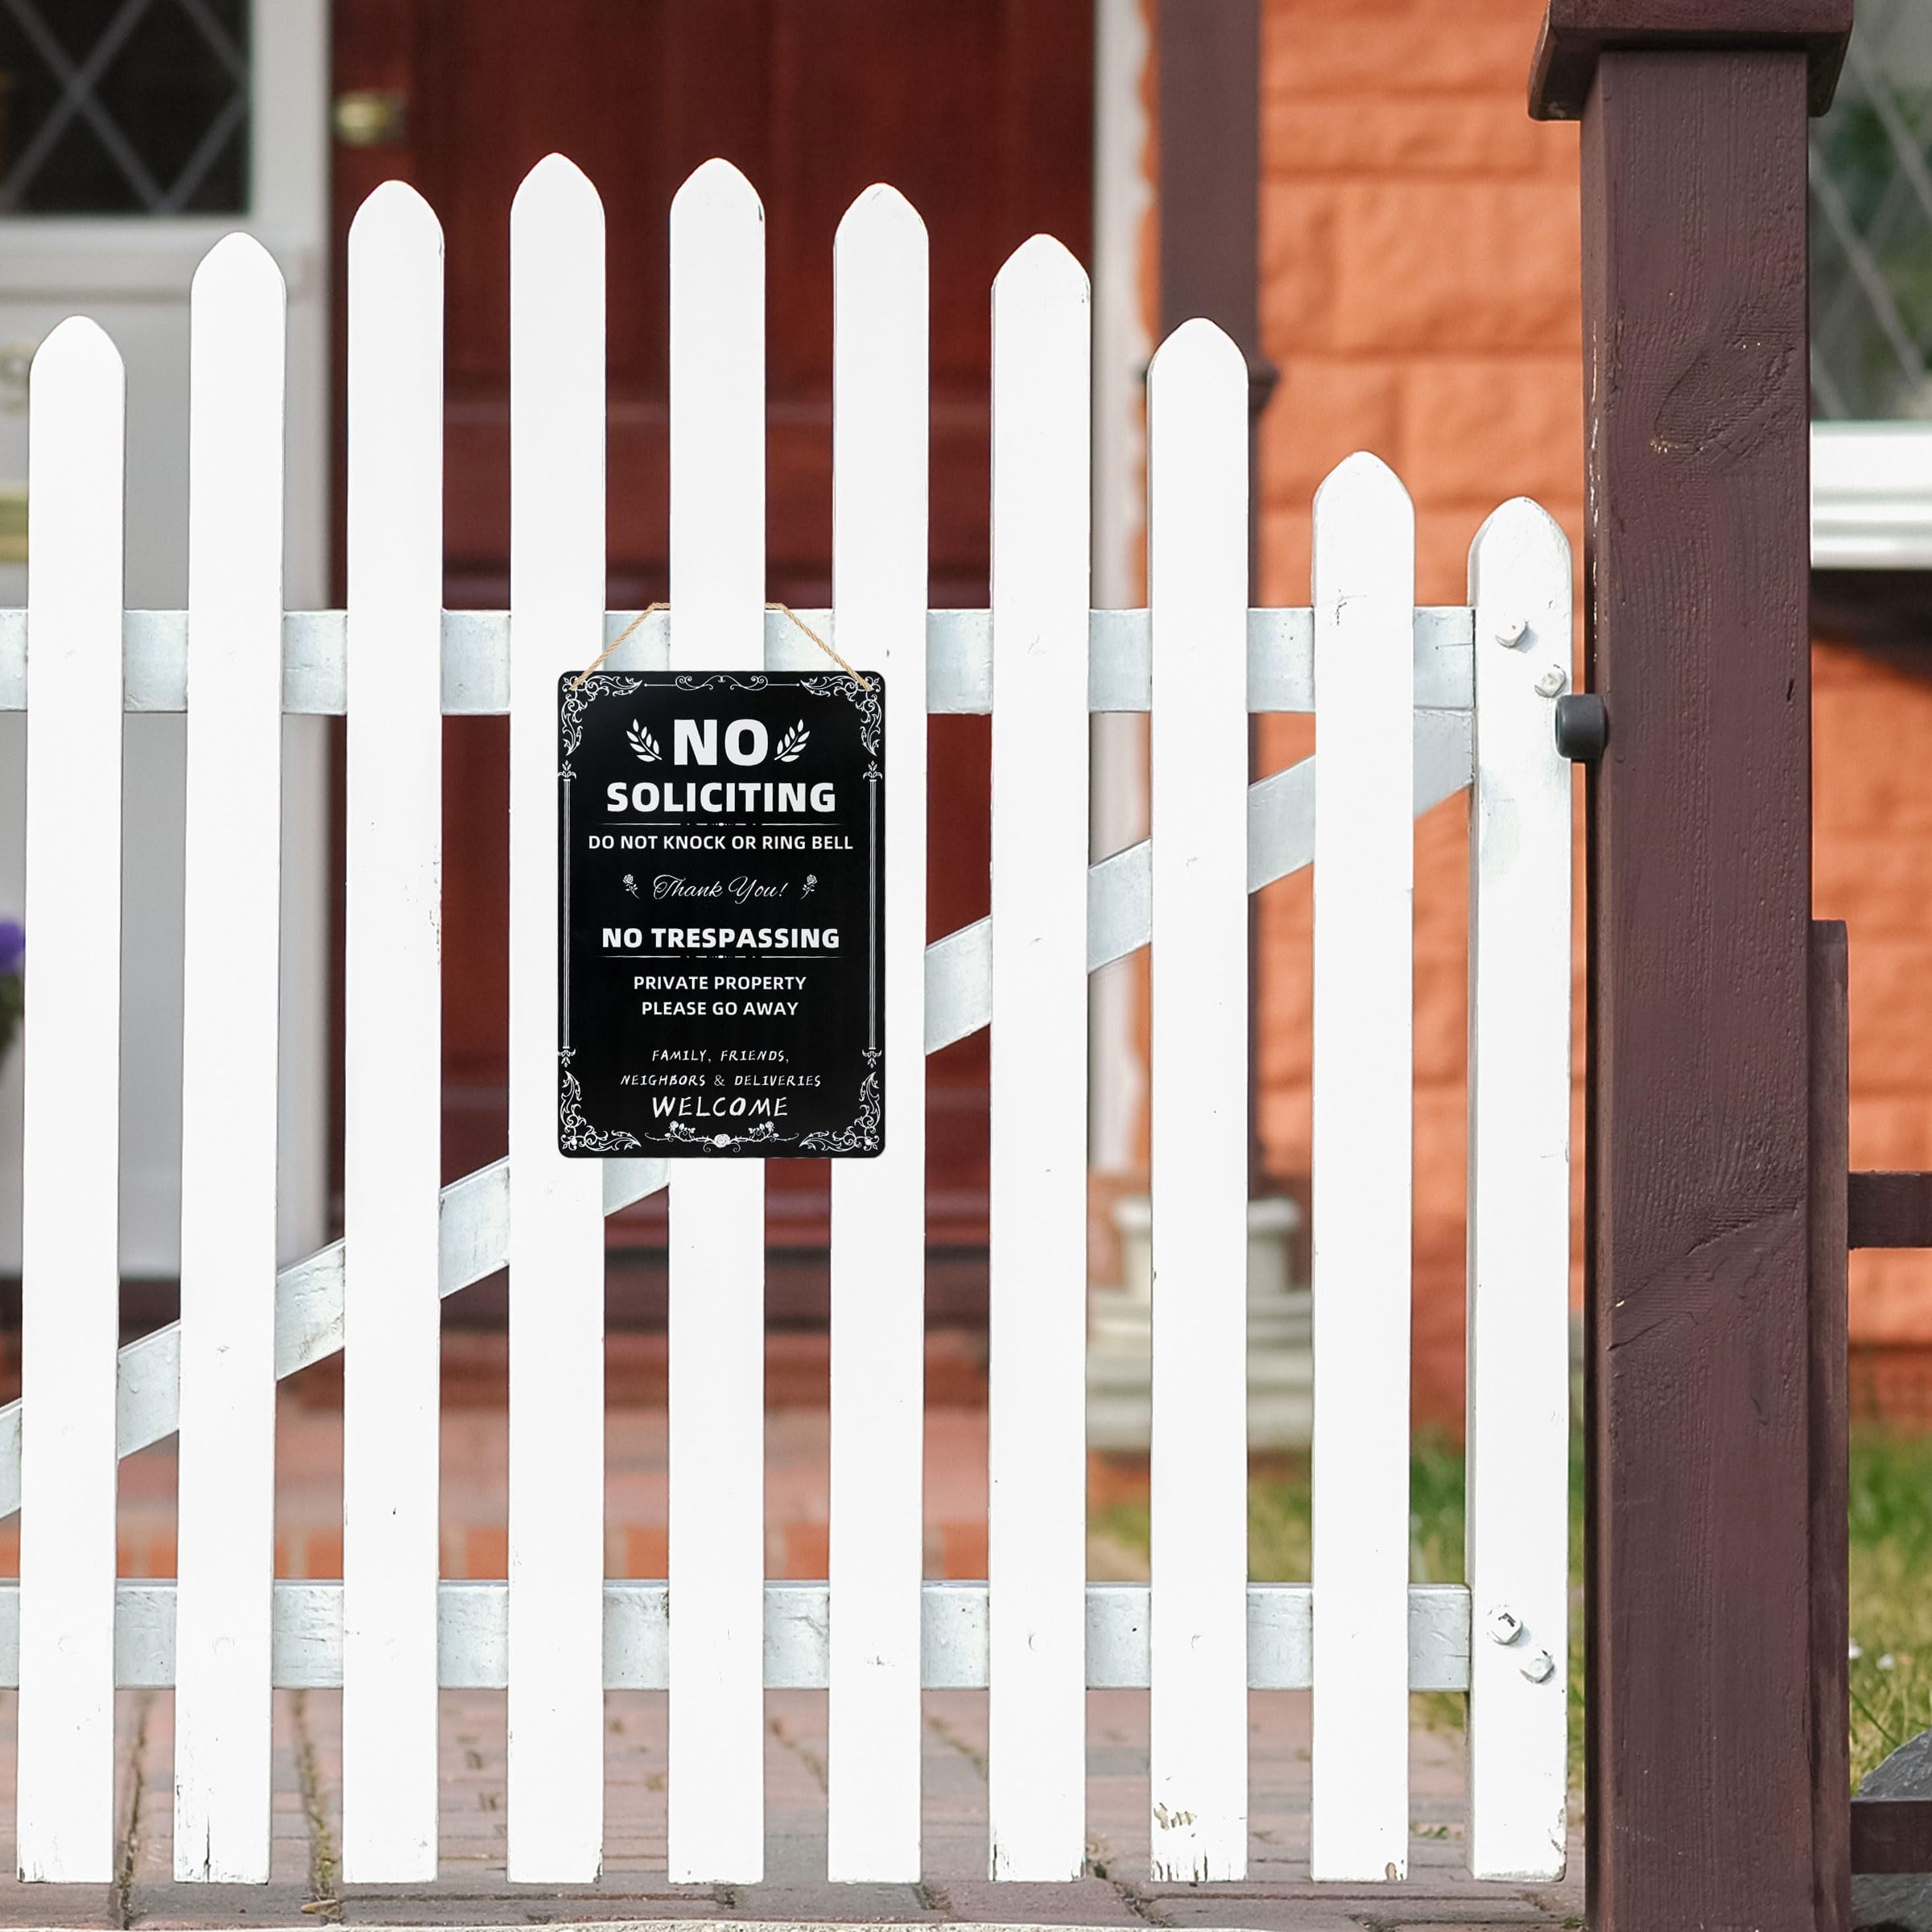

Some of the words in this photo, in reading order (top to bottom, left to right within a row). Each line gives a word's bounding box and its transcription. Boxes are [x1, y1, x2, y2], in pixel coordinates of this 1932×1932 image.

[675, 719, 768, 766] NO
[607, 782, 835, 812] SOLICITING
[589, 836, 614, 848] DO
[621, 836, 658, 849] NOT
[664, 836, 725, 849] KNOCK
[732, 836, 756, 849] OR
[763, 836, 805, 849] RING
[812, 836, 852, 849] BELL
[654, 874, 723, 899] Thank
[729, 877, 788, 904] You!
[603, 928, 642, 947] NO
[651, 928, 839, 948] TRESPASSING
[634, 976, 708, 989] PRIVATE
[715, 976, 806, 989] PROPERTY
[642, 1002, 706, 1015] PLEASE
[712, 1002, 737, 1015] GO
[743, 1002, 799, 1015] AWAY
[653, 1050, 711, 1062] FAMILY,
[720, 1051, 788, 1063] FRIENDS,
[621, 1075, 705, 1086] NEIGHBORS
[714, 1075, 725, 1086] &
[735, 1075, 820, 1087] DELIVERIES
[653, 1096, 787, 1117] WELCOME
